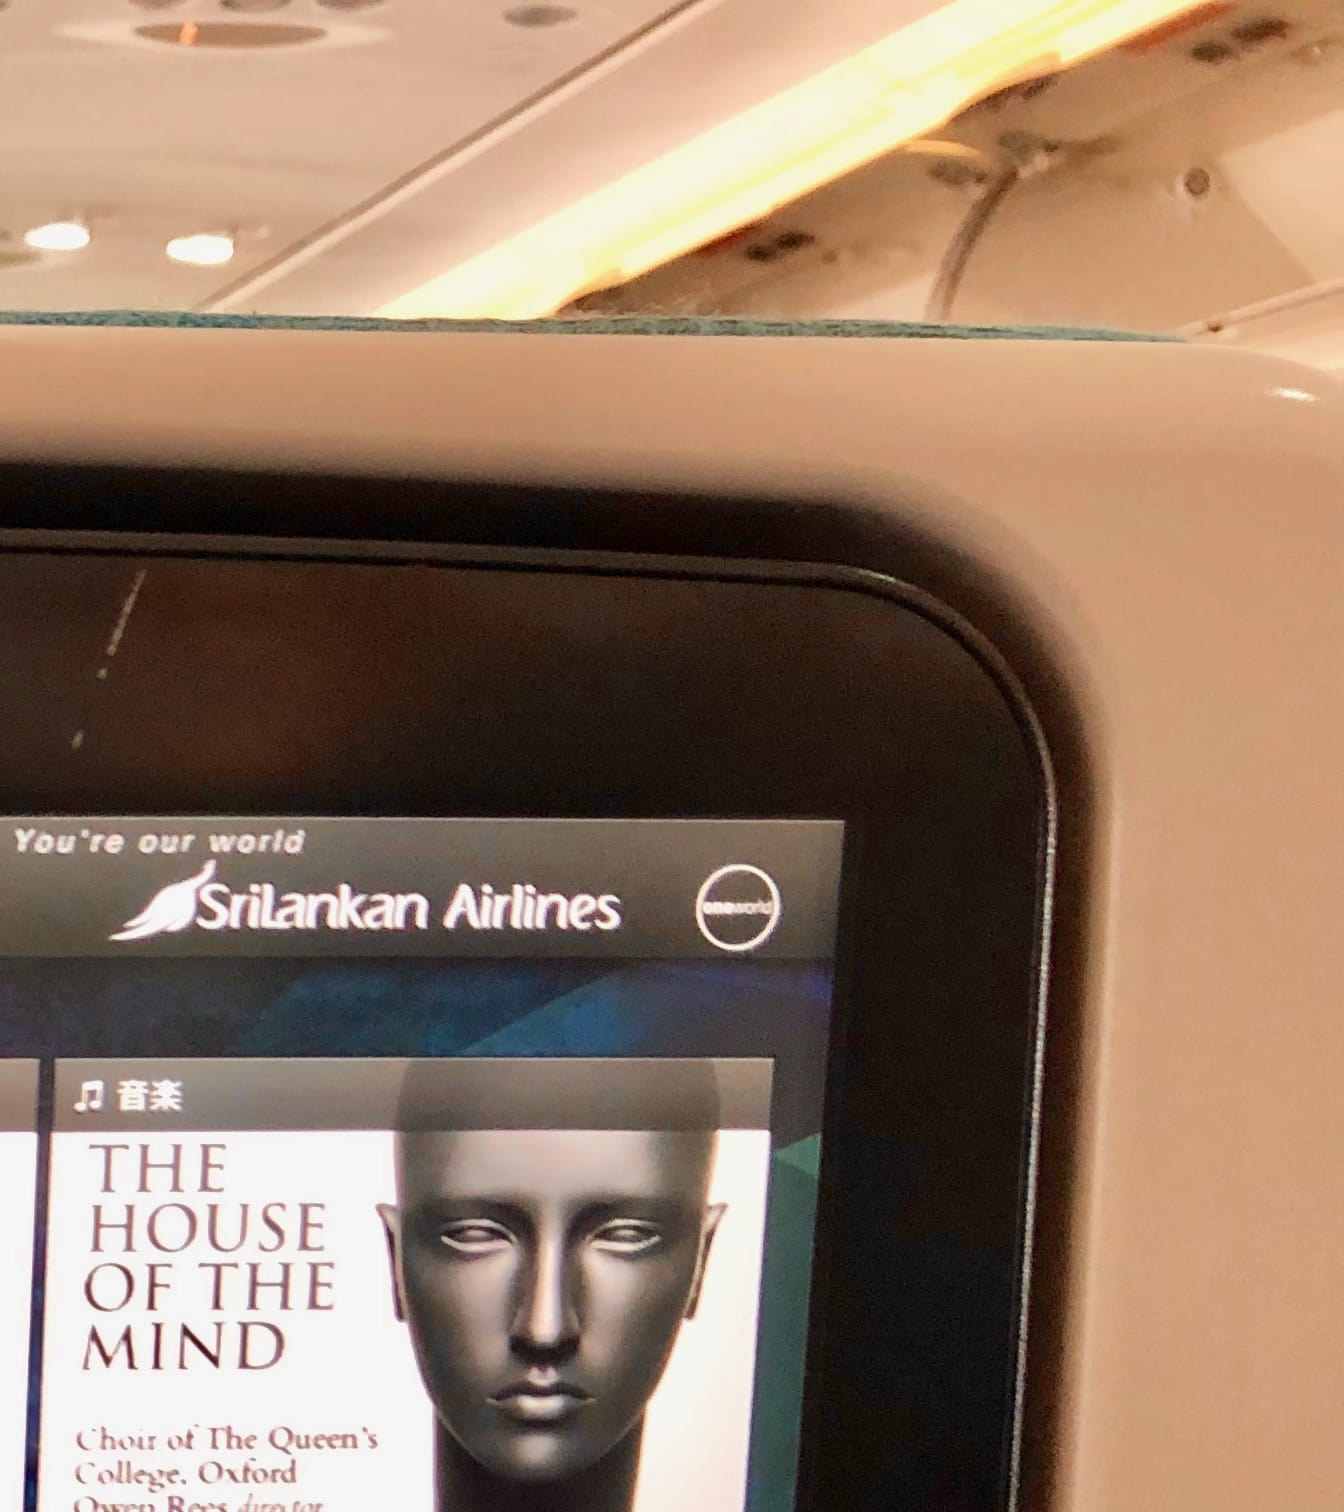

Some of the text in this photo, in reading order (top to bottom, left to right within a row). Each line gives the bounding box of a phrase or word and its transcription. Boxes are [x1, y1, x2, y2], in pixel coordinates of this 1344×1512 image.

[14, 827, 307, 854] You're our world
[194, 882, 623, 930] SriLankan Airlines
[116, 1079, 183, 1114] 音楽
[88, 1143, 227, 1194] THE
[90, 1202, 326, 1253] HOUSE
[82, 1261, 335, 1312] OF THE
[81, 1320, 286, 1371] MIND
[76, 1424, 379, 1455] Choir of The Queen's
[198, 1457, 297, 1484] Oxford
